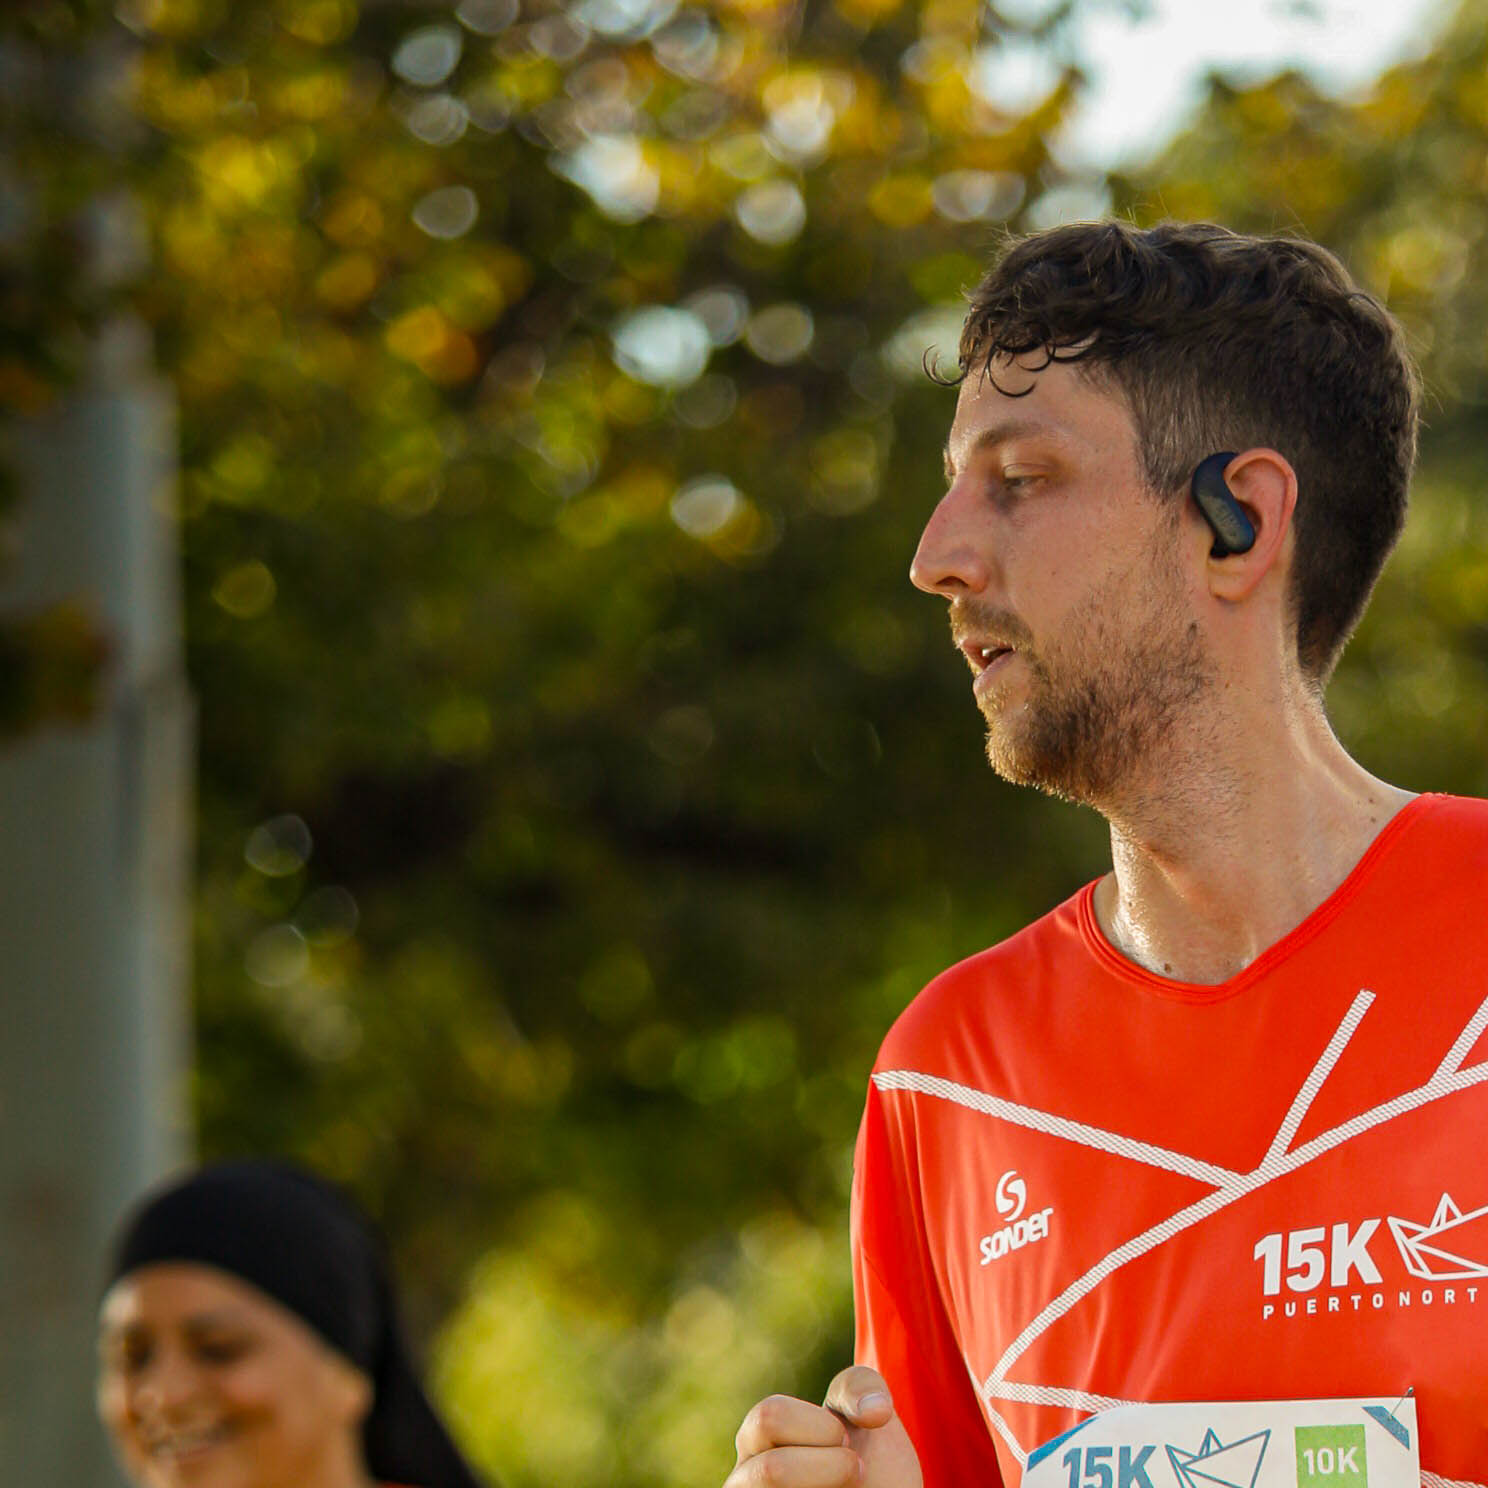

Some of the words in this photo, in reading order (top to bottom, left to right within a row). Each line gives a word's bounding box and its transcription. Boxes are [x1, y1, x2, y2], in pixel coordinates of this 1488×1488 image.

[1254, 1218, 1384, 1297] 15K
[1263, 1292, 1385, 1321] PUERTO
[1303, 1446, 1360, 1477] 10K
